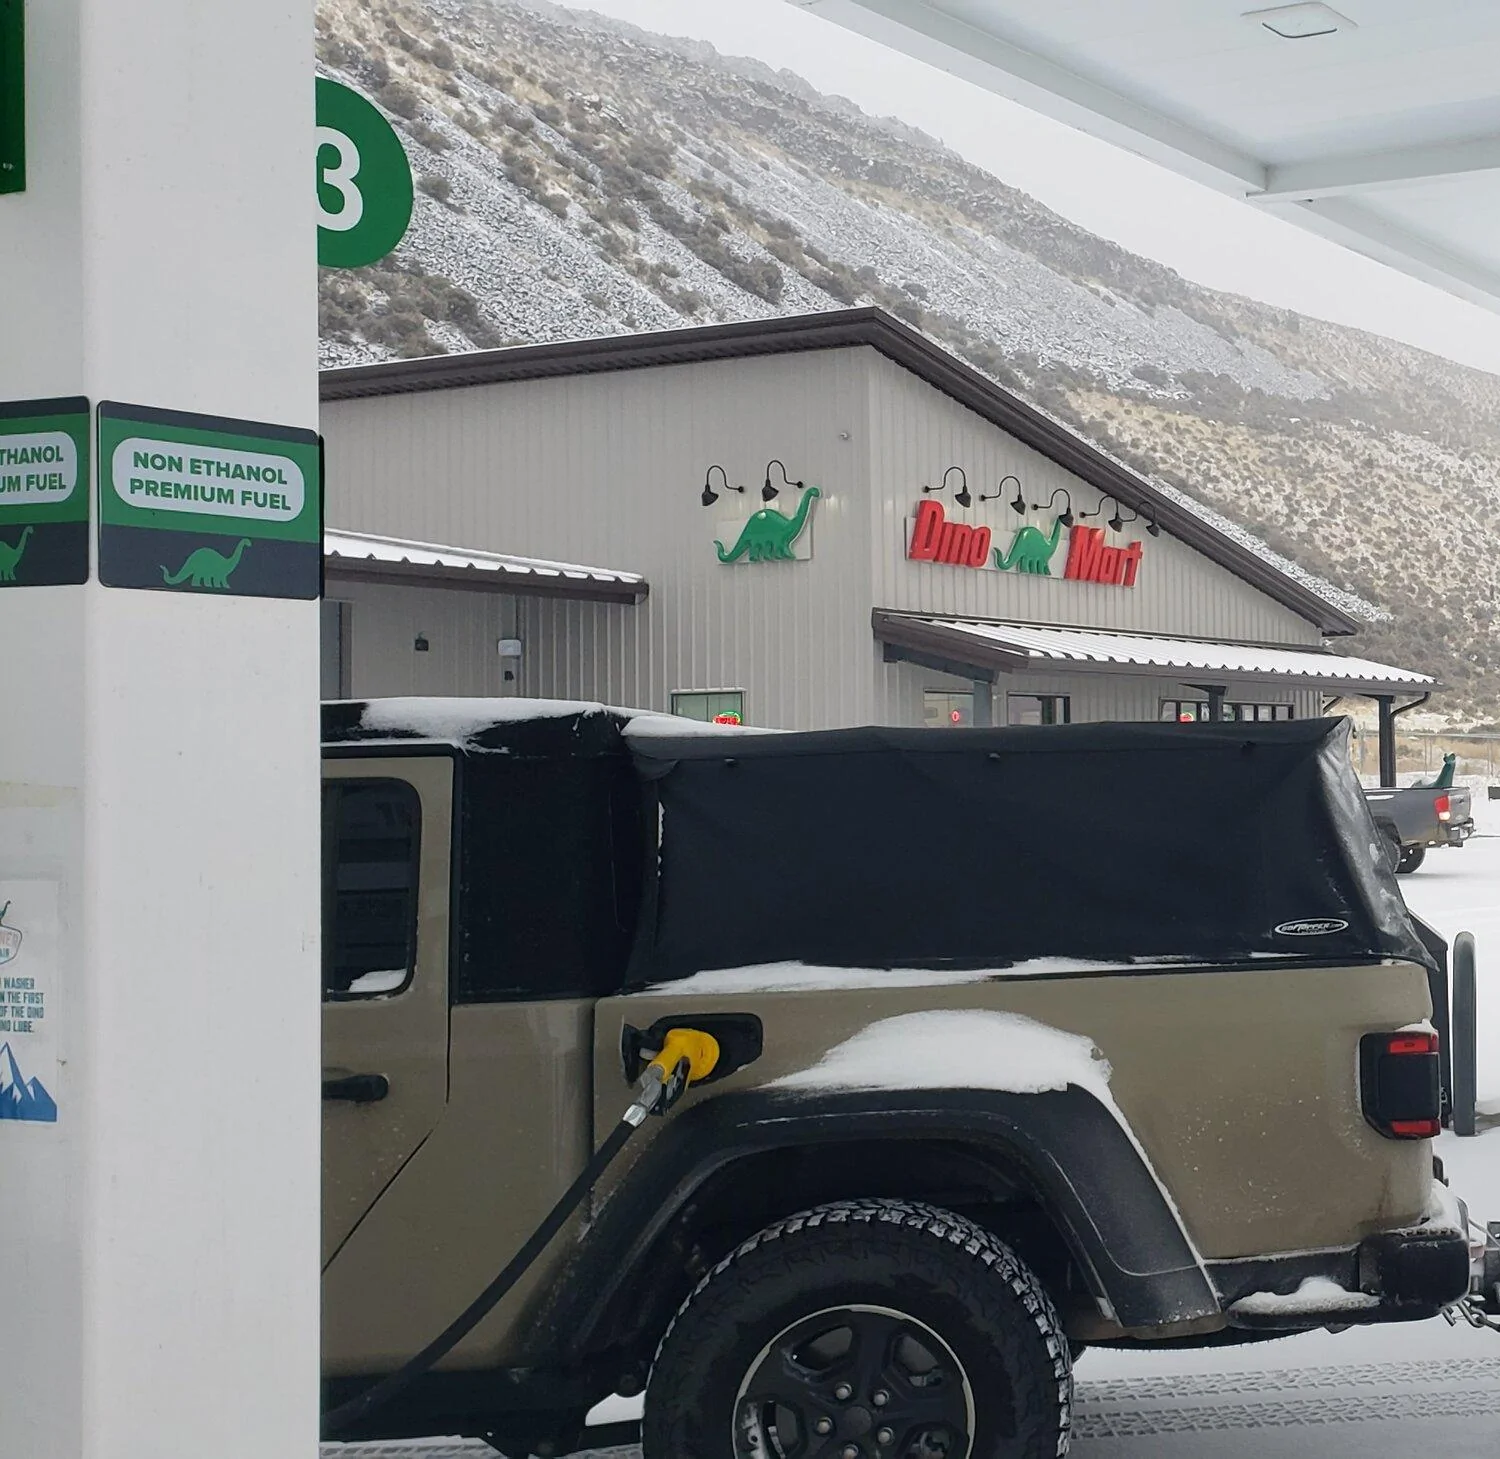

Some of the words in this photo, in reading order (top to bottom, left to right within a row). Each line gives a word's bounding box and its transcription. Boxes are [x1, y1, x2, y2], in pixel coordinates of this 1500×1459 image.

[316, 126, 363, 232] 3
[0, 446, 64, 466] THANOL
[133, 451, 183, 473] NON
[189, 458, 288, 485] ETHANOL
[26, 472, 67, 492] FUEL
[130, 478, 235, 506] PREMIUM
[241, 491, 292, 511] FUEL
[909, 499, 992, 568] Dino
[1064, 524, 1144, 588] Mart
[4, 977, 35, 989] WASHER
[8, 991, 21, 1003] THE
[23, 992, 44, 1004] FIRST
[11, 1005, 25, 1018] THE
